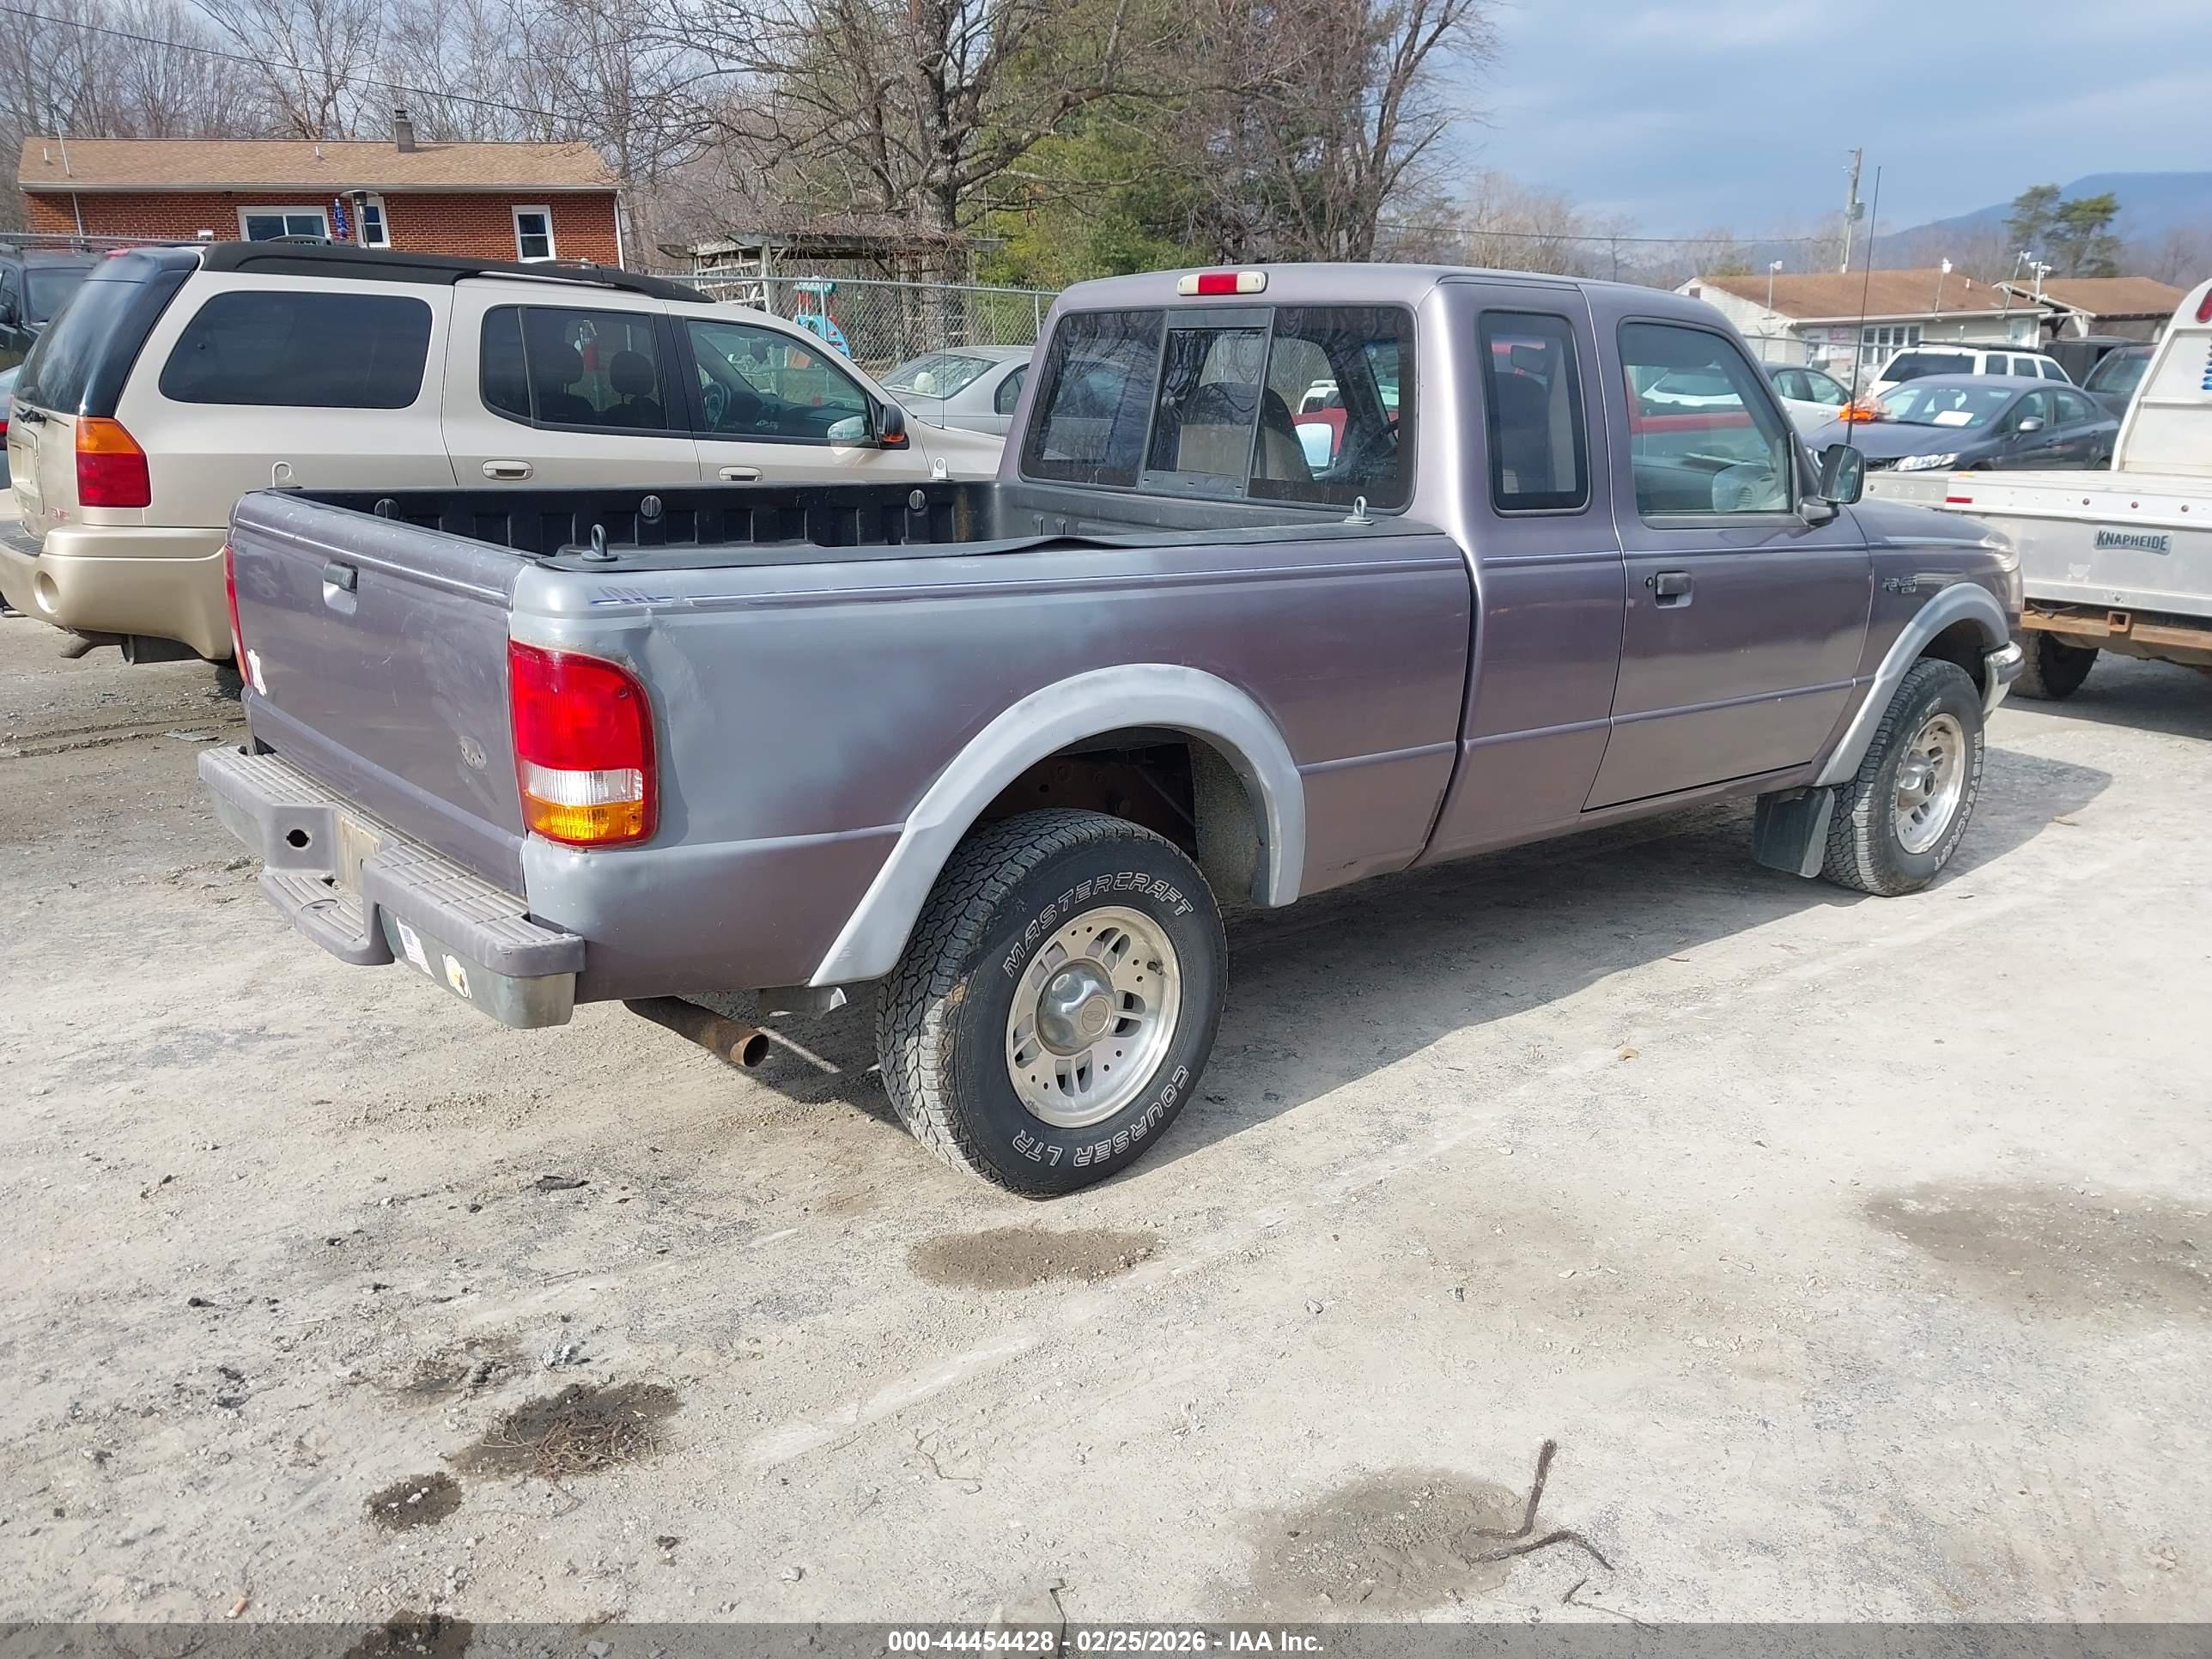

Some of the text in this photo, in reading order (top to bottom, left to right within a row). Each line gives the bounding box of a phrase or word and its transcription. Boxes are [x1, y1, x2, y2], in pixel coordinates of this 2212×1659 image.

[2096, 530, 2169, 551] KNAPHEIDE
[1002, 872, 1194, 979] MASTERCRAFT
[1012, 1064, 1189, 1168] COURSER LTR
